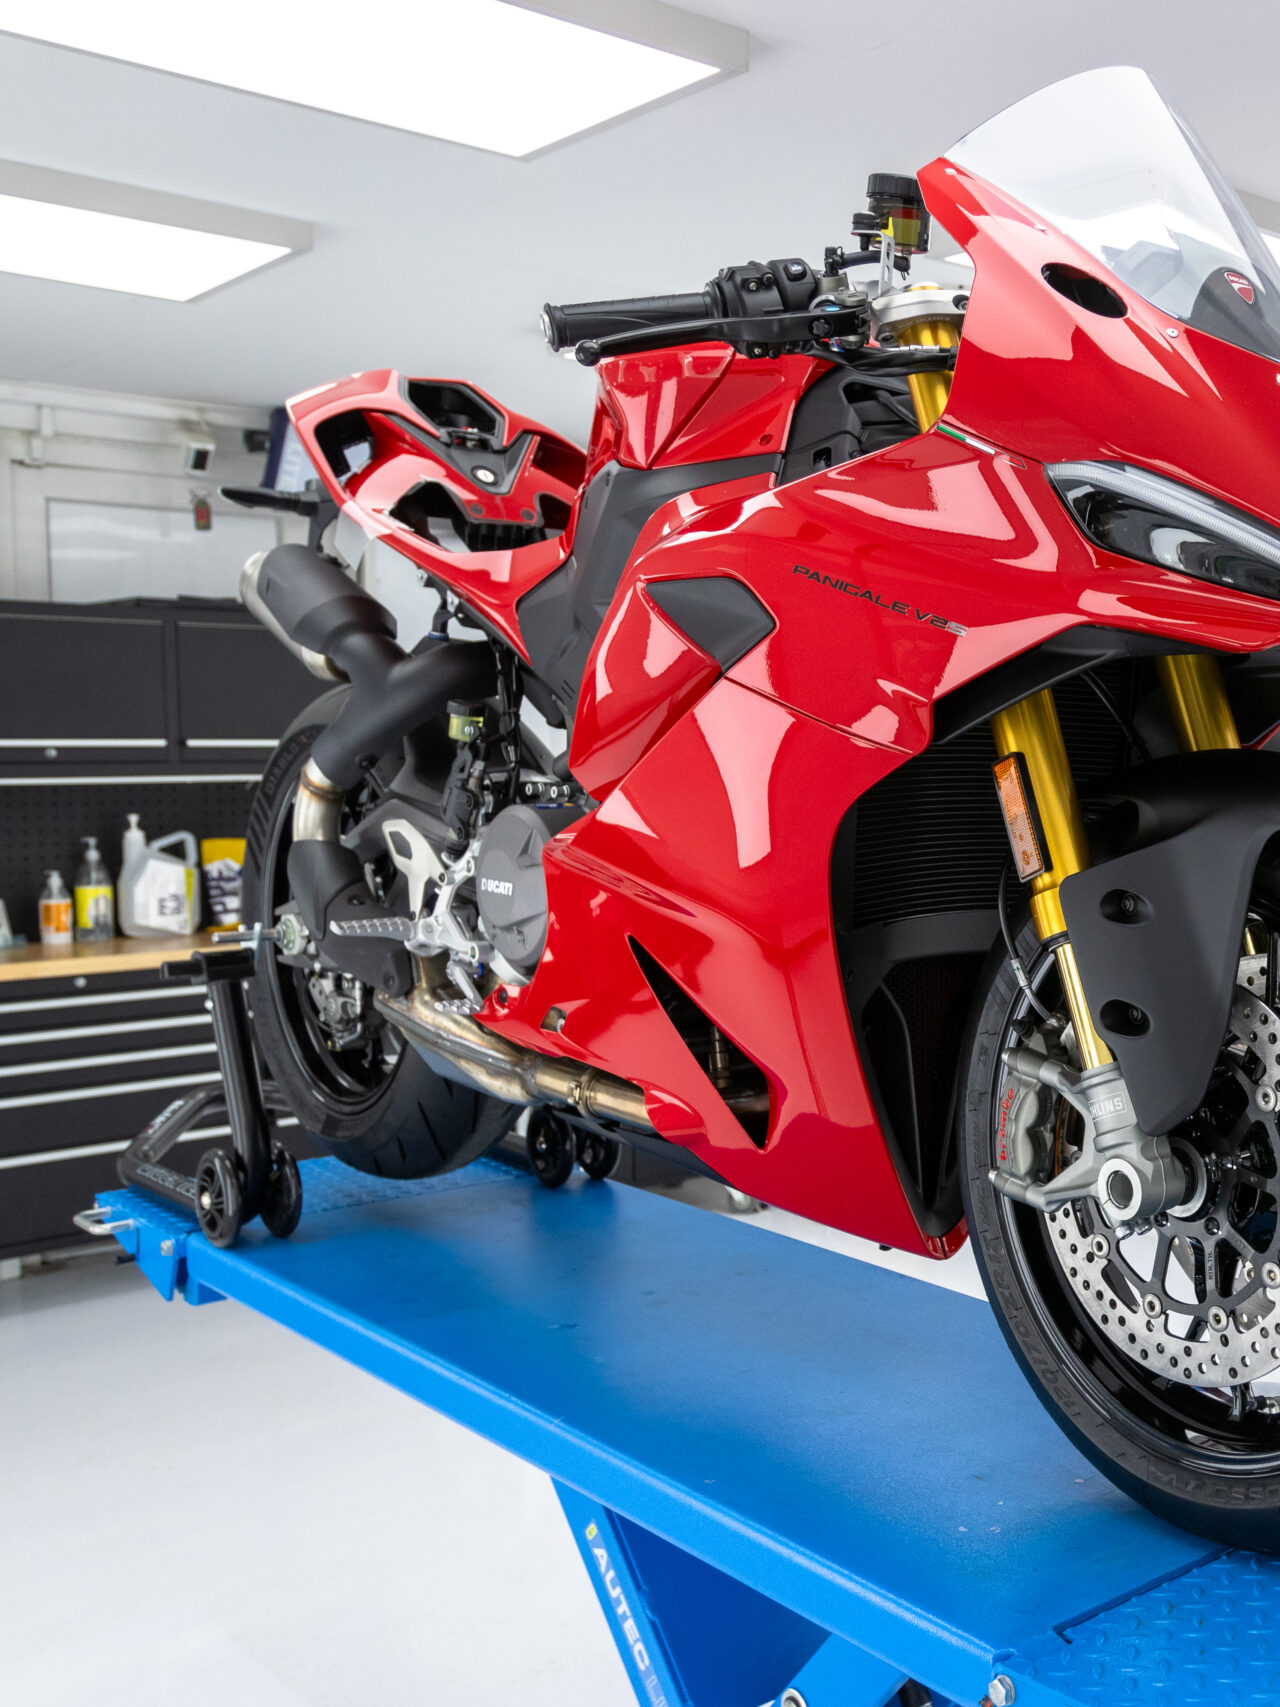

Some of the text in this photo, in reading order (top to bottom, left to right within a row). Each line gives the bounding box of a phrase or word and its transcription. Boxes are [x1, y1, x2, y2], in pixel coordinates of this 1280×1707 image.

[792, 564, 911, 616] PANIGALE
[481, 878, 513, 897] DUCATI
[998, 1088, 1015, 1162] brembo
[592, 1547, 651, 1672] AUTEC
